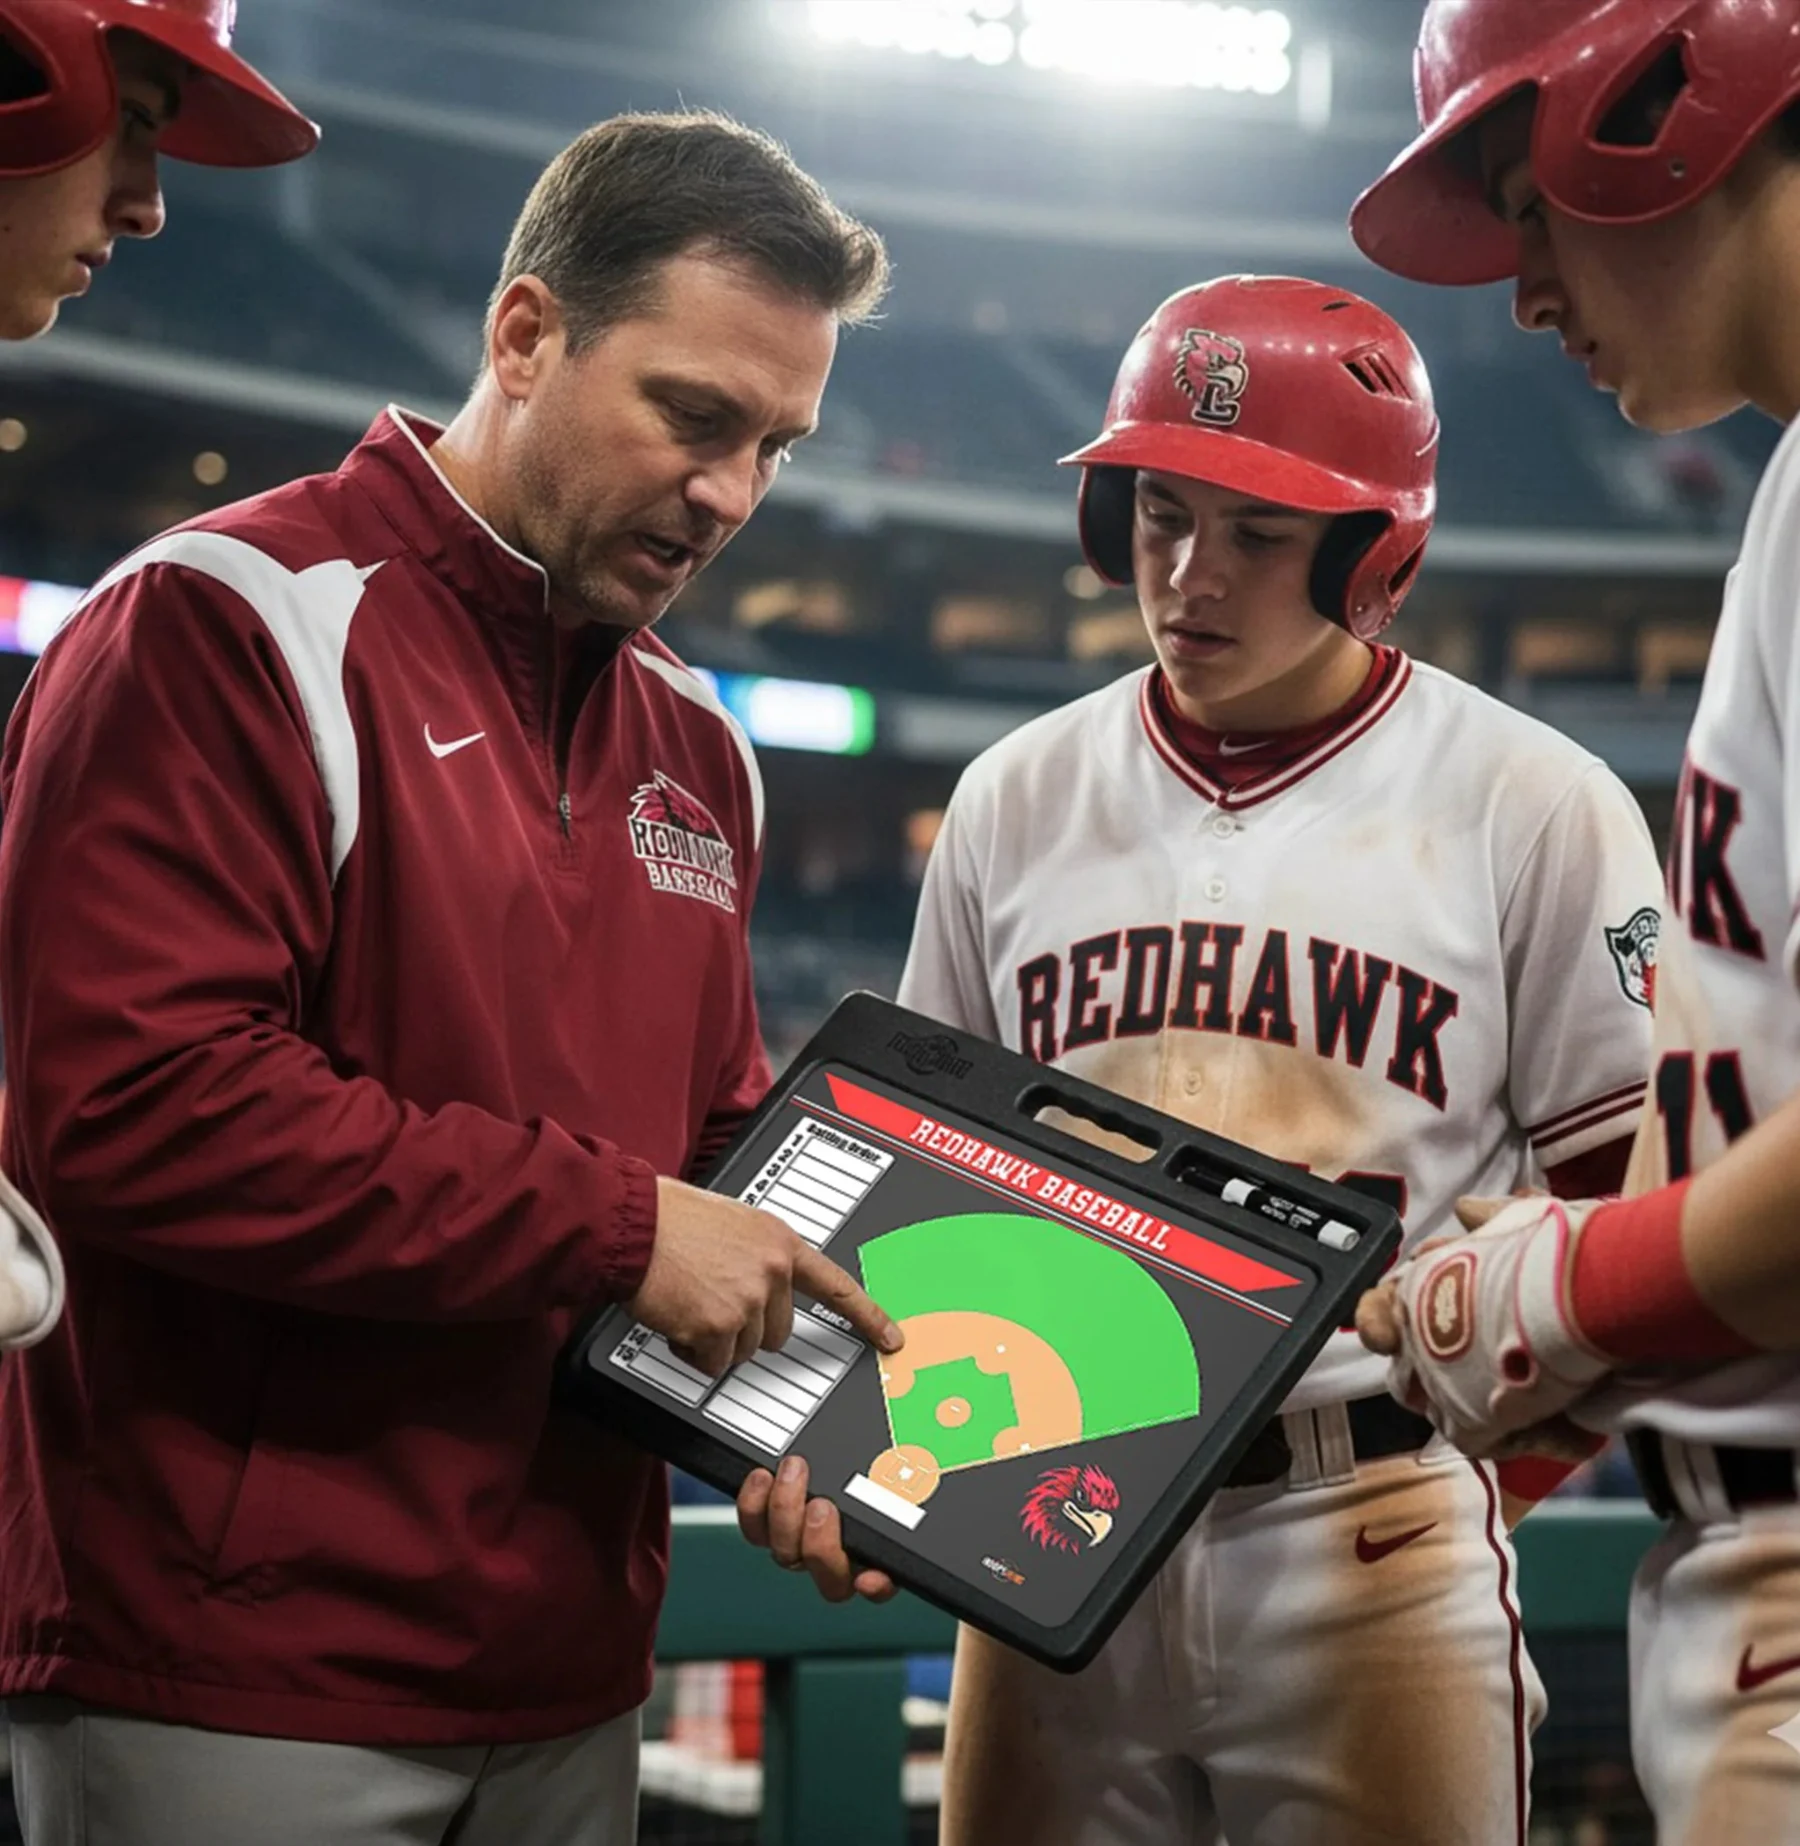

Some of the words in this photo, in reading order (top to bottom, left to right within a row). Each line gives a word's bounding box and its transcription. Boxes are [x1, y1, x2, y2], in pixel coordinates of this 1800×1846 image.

[1666, 762, 1768, 962] K
[1018, 919, 1459, 1112] REDHAWK
[792, 1133, 803, 1147] 1
[1656, 1049, 1756, 1185] 11
[754, 1179, 768, 1193] 4
[766, 1163, 781, 1178] 3
[777, 1148, 793, 1163] 2
[909, 1118, 1039, 1189] REDHAWK
[1036, 1174, 1172, 1251] BASEBALL
